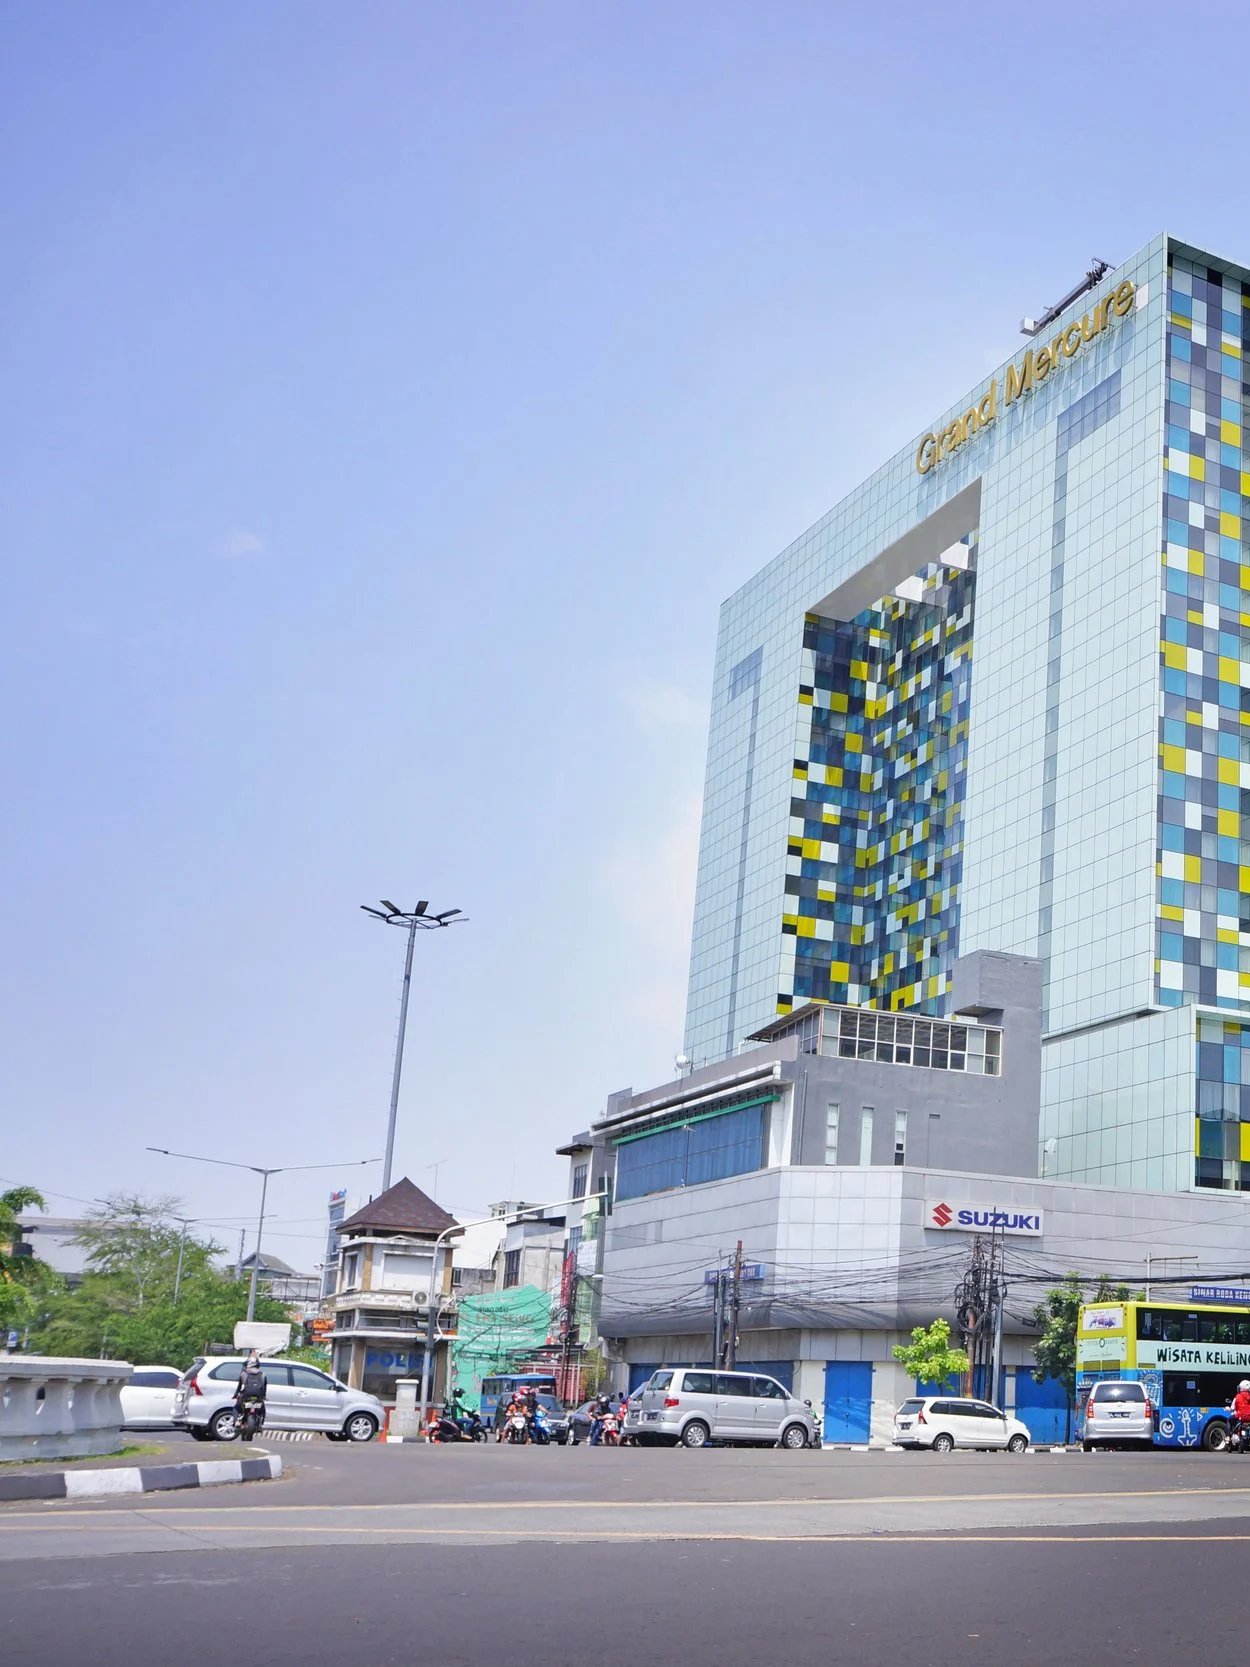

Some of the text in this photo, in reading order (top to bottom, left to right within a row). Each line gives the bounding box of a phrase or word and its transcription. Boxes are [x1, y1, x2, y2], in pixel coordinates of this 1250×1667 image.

[916, 279, 1135, 475] Grand Mercure
[957, 1209, 1040, 1231] SUZUKI
[1193, 1288, 1215, 1298] SINAR
[1216, 1289, 1234, 1300] RODA
